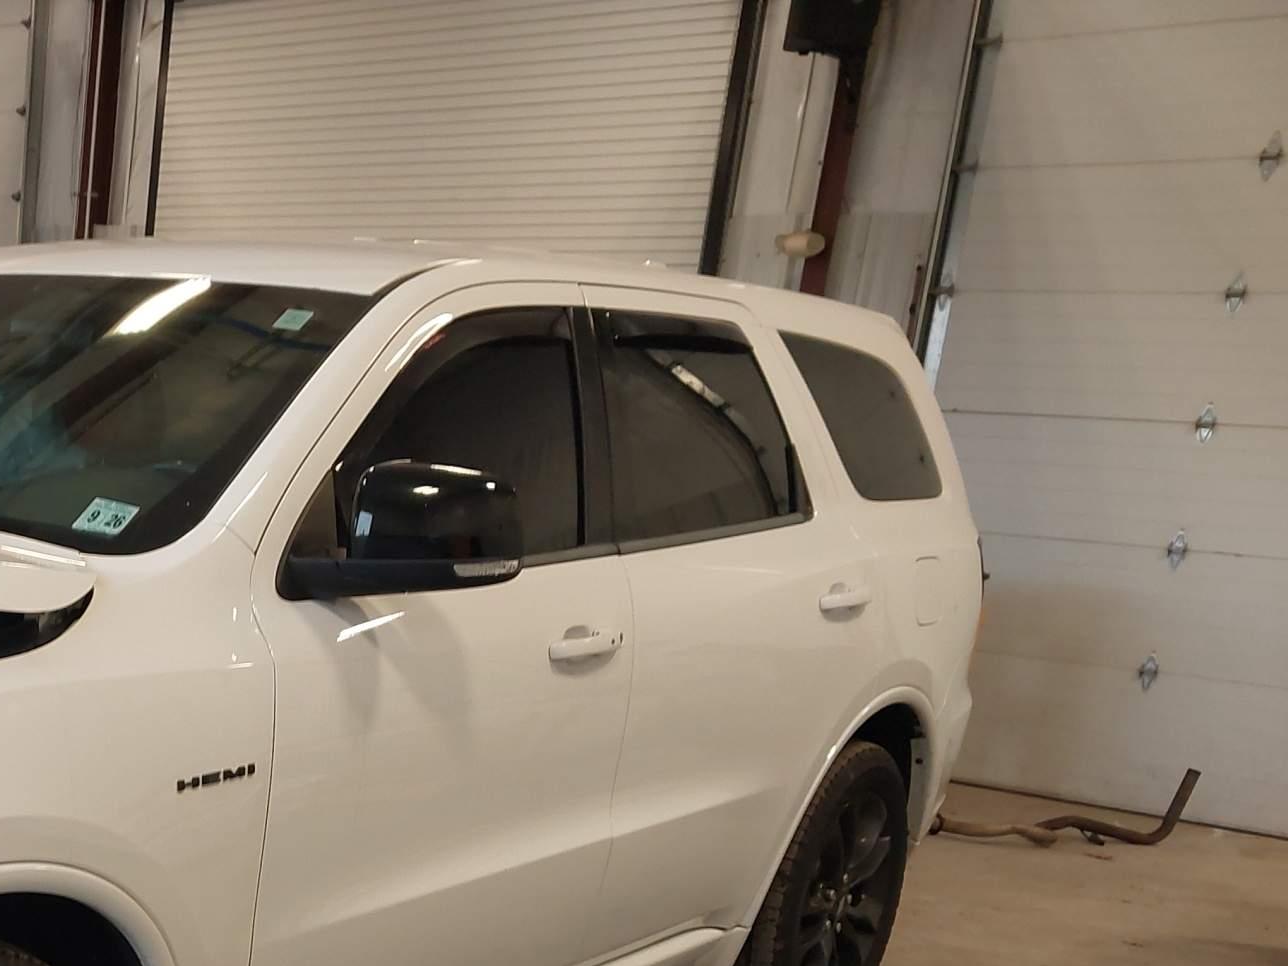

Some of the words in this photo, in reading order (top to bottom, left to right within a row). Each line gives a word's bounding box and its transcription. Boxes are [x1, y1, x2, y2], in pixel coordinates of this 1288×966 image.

[87, 509, 101, 523] 9
[104, 513, 126, 529] 26
[177, 763, 255, 792] HEMI
